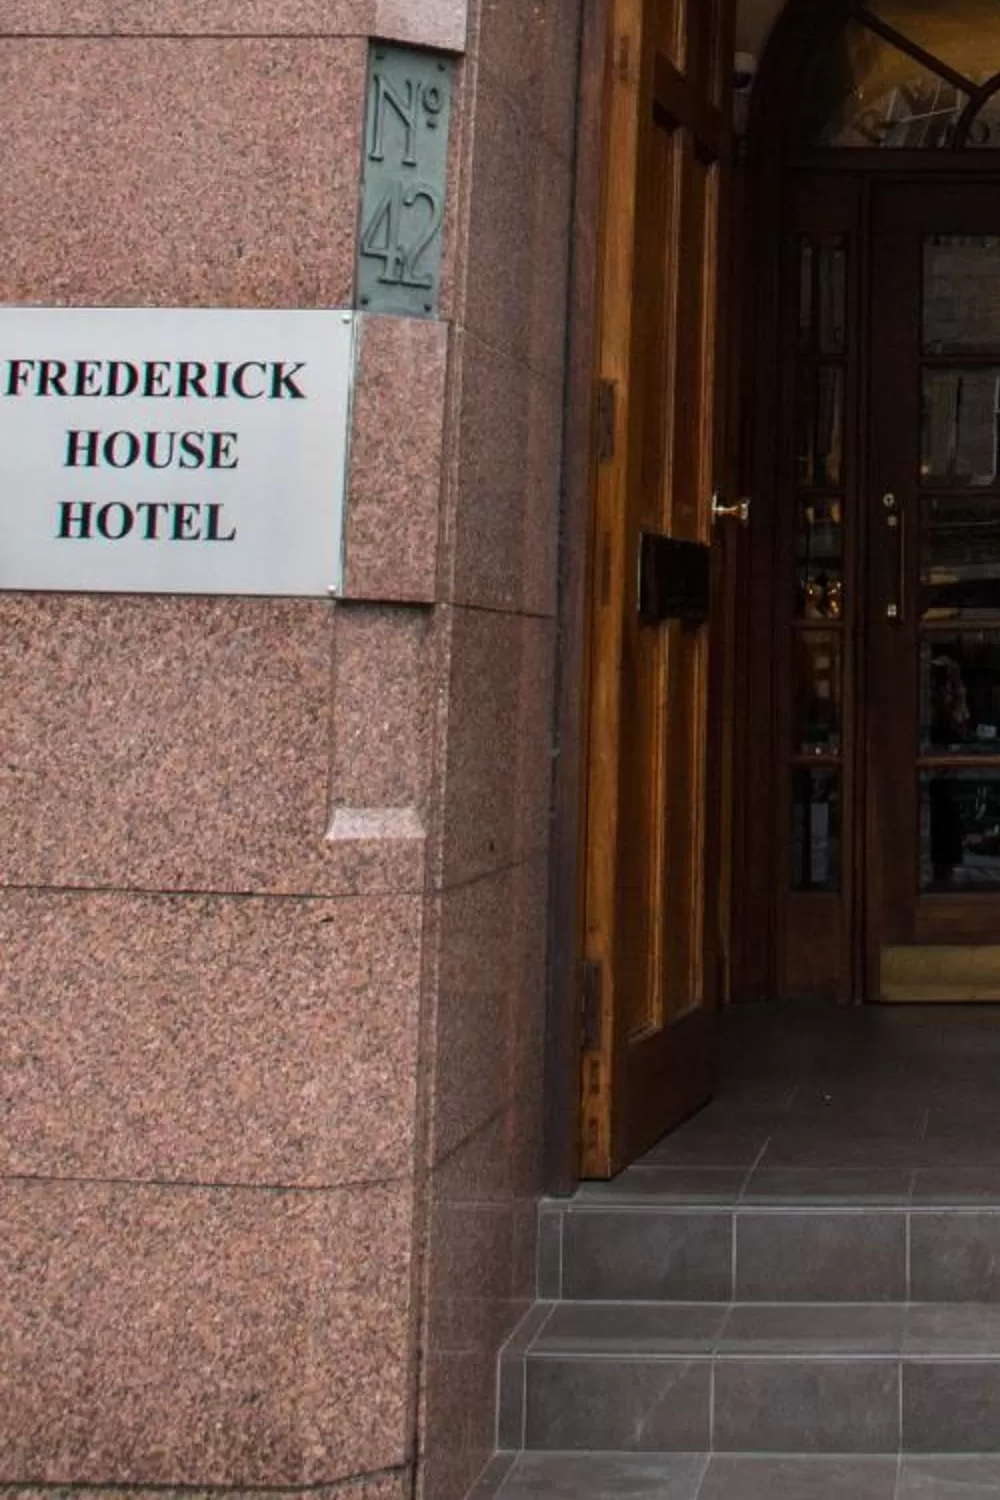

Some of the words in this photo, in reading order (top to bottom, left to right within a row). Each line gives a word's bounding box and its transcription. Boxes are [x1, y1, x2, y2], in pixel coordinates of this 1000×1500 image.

[360, 182, 443, 290] 42
[3, 358, 307, 399] FREDERICK
[62, 429, 239, 469] HOUSE
[55, 500, 237, 541] HOTEL
